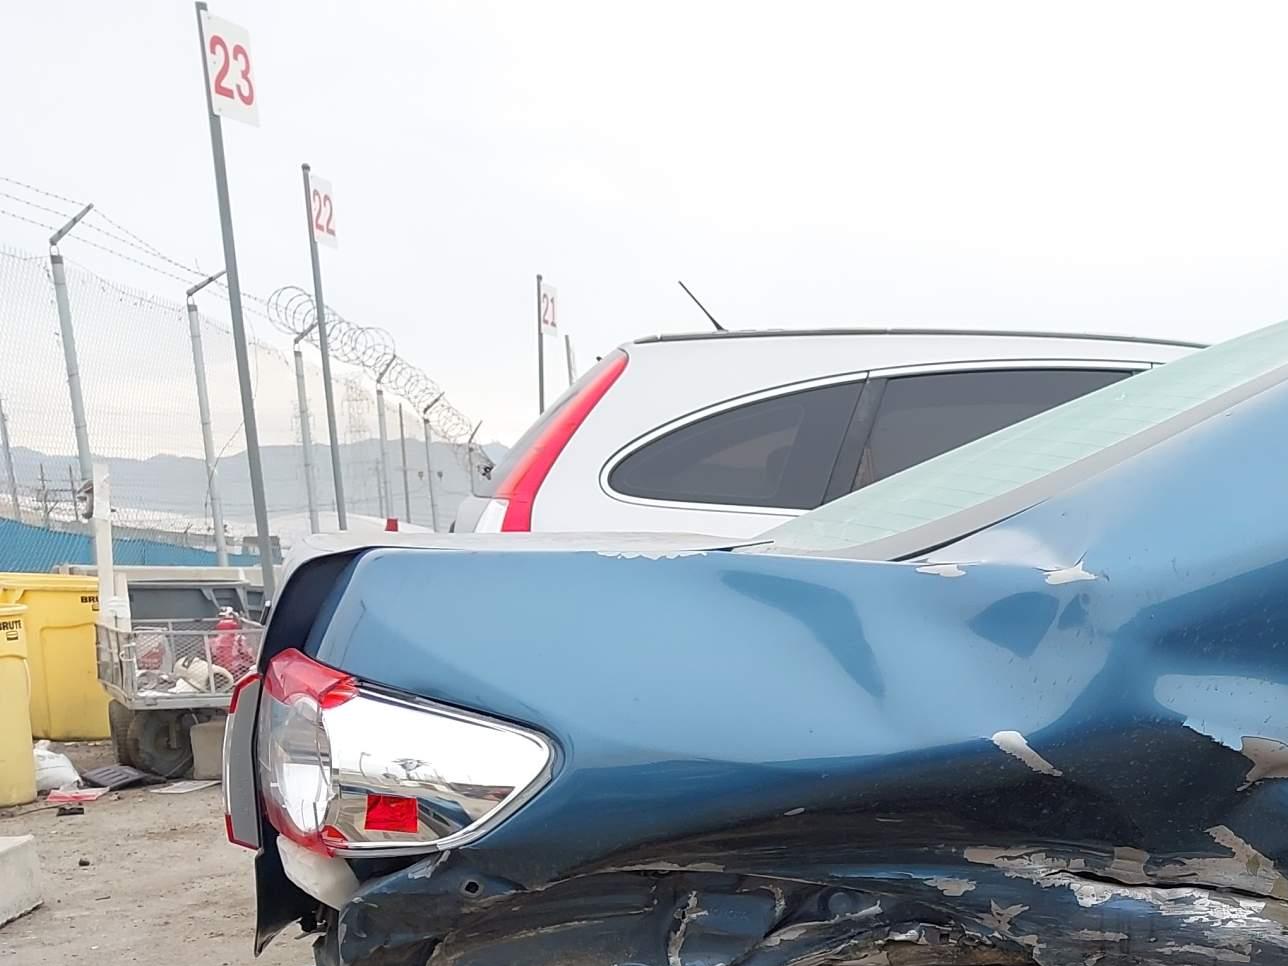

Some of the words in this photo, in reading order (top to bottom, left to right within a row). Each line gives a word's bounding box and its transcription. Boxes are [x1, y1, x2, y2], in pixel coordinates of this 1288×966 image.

[210, 35, 254, 106] 23
[312, 189, 336, 237] 22
[542, 293, 556, 328] 21
[0, 620, 22, 631] RUTE
